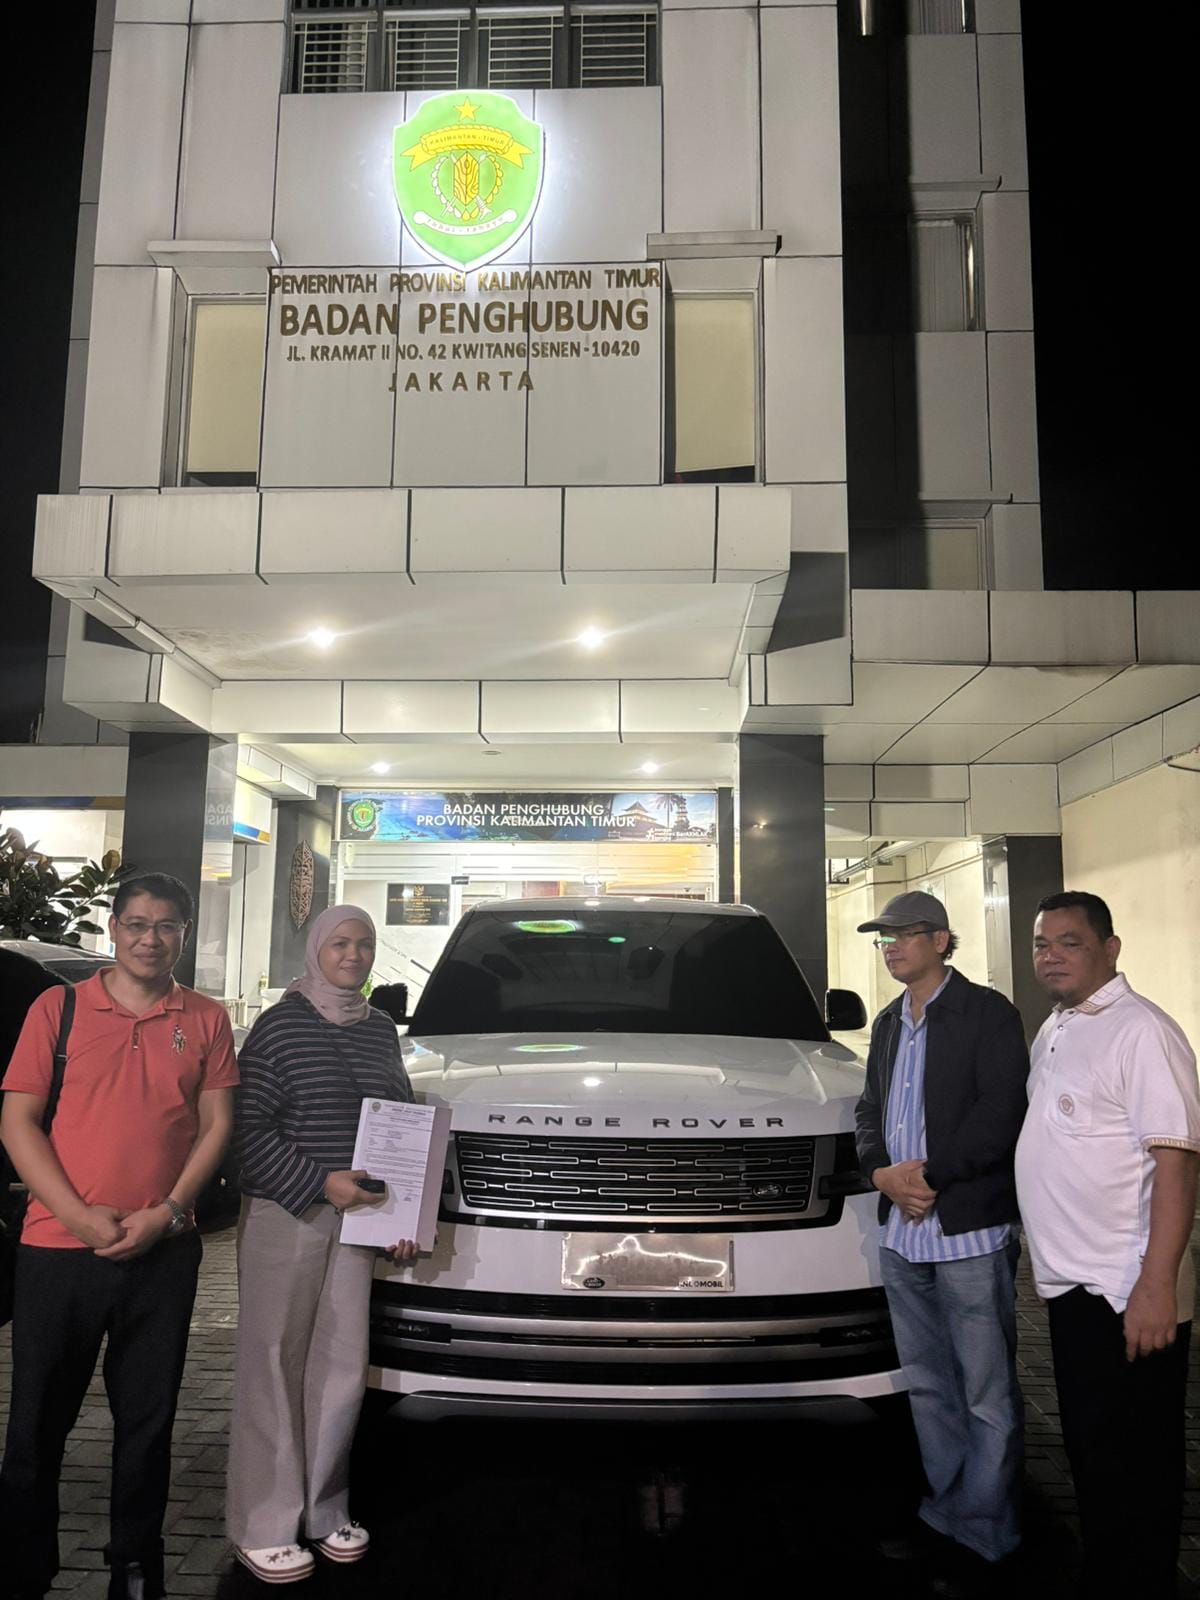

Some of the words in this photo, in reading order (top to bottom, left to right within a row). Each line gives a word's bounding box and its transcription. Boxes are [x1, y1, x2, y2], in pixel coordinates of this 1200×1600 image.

[270, 274, 377, 295] PEMERINTAH
[389, 272, 466, 293] PROVINSI
[477, 269, 592, 291] KALIMANTAN
[604, 267, 661, 288] TIMUR
[280, 303, 398, 336] BADAN
[418, 298, 648, 334] PENGHUBUNG
[286, 345, 306, 361] JL.
[310, 345, 376, 361] KRAMAT
[381, 344, 390, 360] II
[397, 344, 424, 360] NO.
[427, 343, 447, 360] 42
[452, 342, 527, 359] KWITANG
[388, 370, 534, 392] JAKARTA
[443, 803, 496, 815] BADAN
[500, 803, 605, 815] PENGHUBUNG
[416, 815, 485, 826] PROVINSI
[490, 815, 586, 827] KALIMANTAN
[590, 815, 636, 827] TIMUR
[487, 1113, 621, 1127] RANGE
[652, 1117, 784, 1129] ROVER
